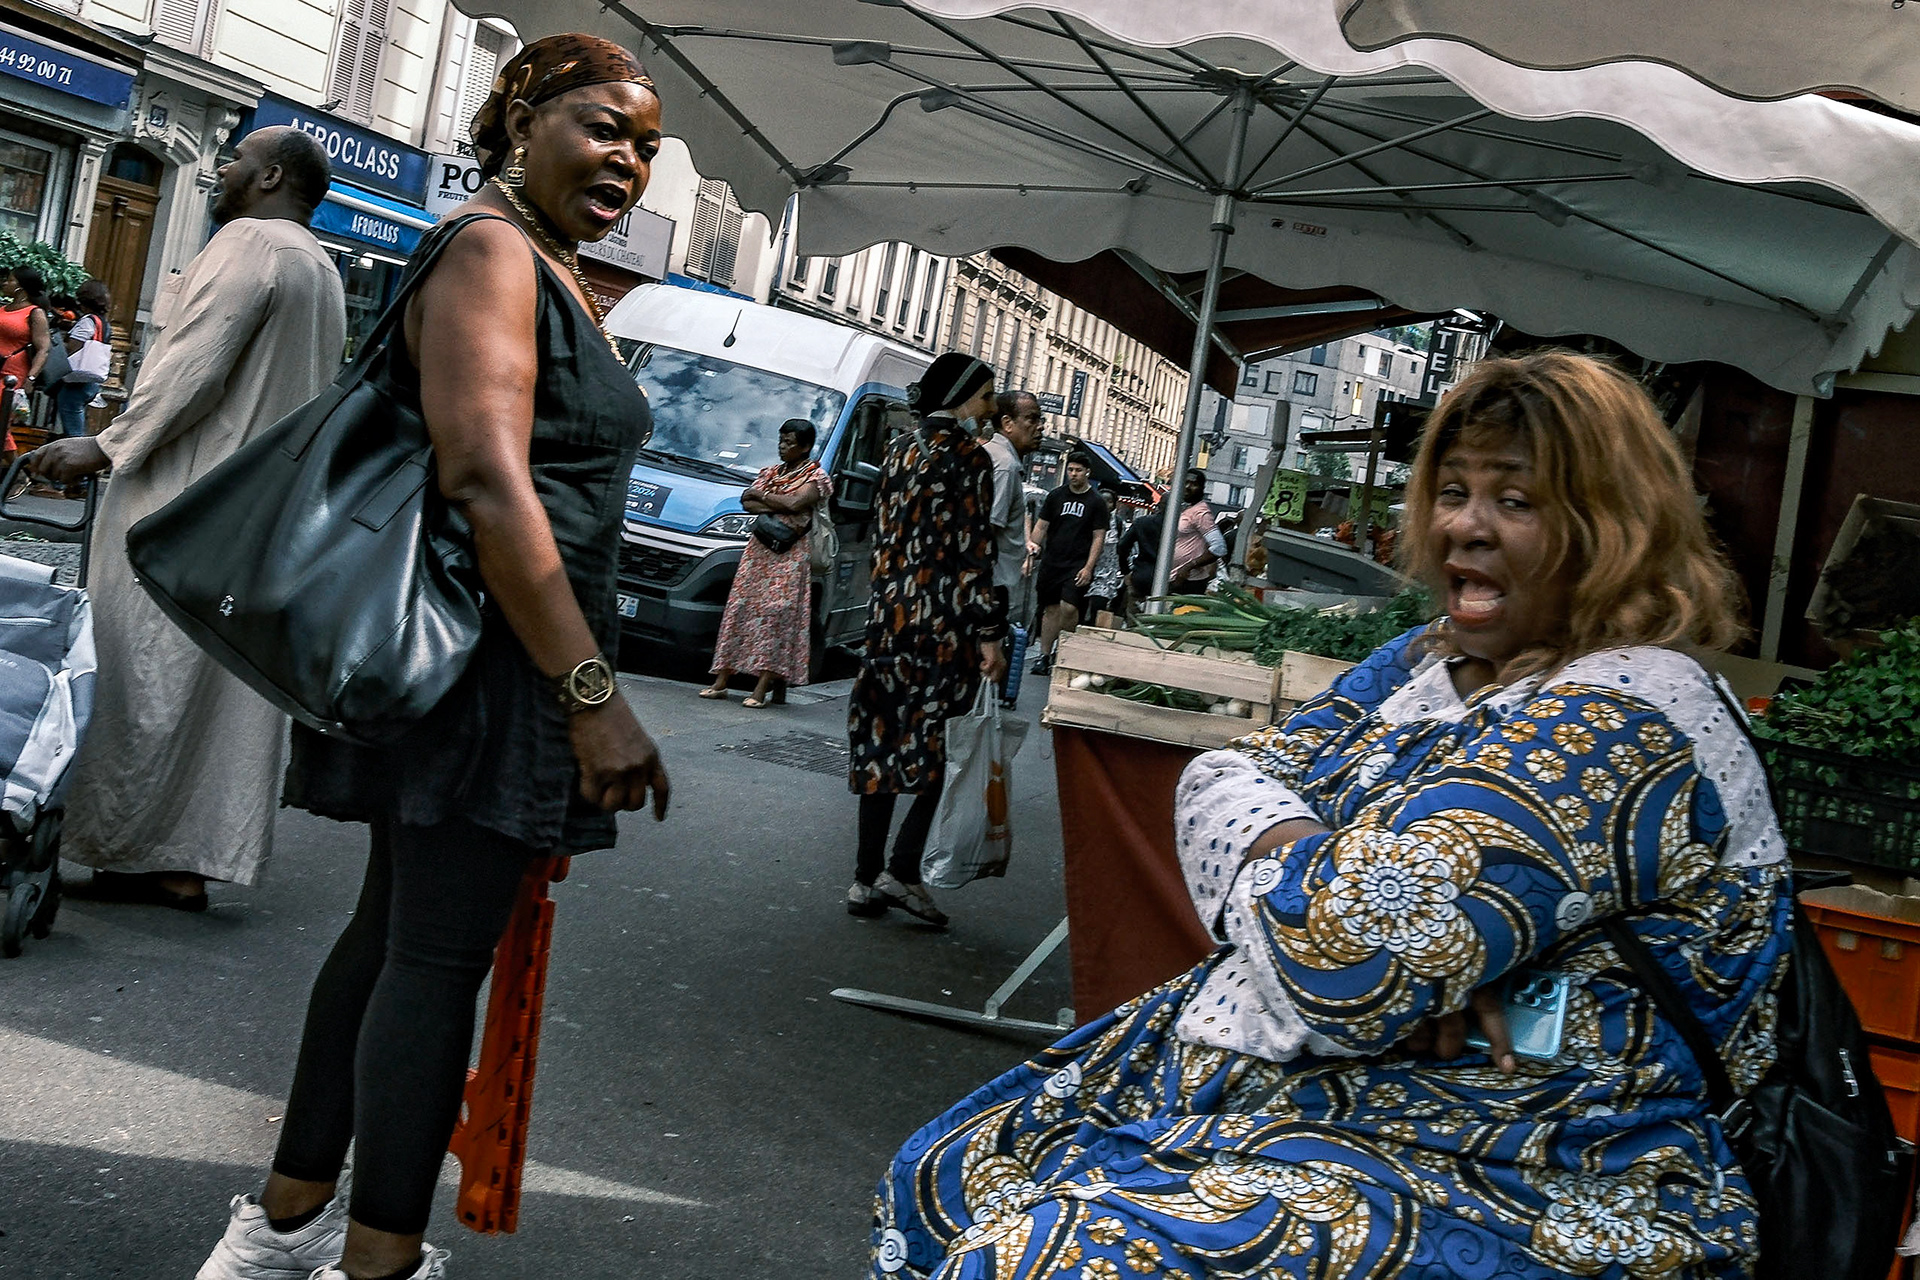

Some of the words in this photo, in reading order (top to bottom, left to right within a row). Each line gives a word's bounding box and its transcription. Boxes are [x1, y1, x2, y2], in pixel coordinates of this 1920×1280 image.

[16, 52, 36, 74] 92
[37, 59, 58, 80] 00
[57, 66, 73, 86] 71
[350, 213, 399, 244] AFROCLASS
[1426, 317, 1457, 394] TEL
[1060, 501, 1085, 518] DAD
